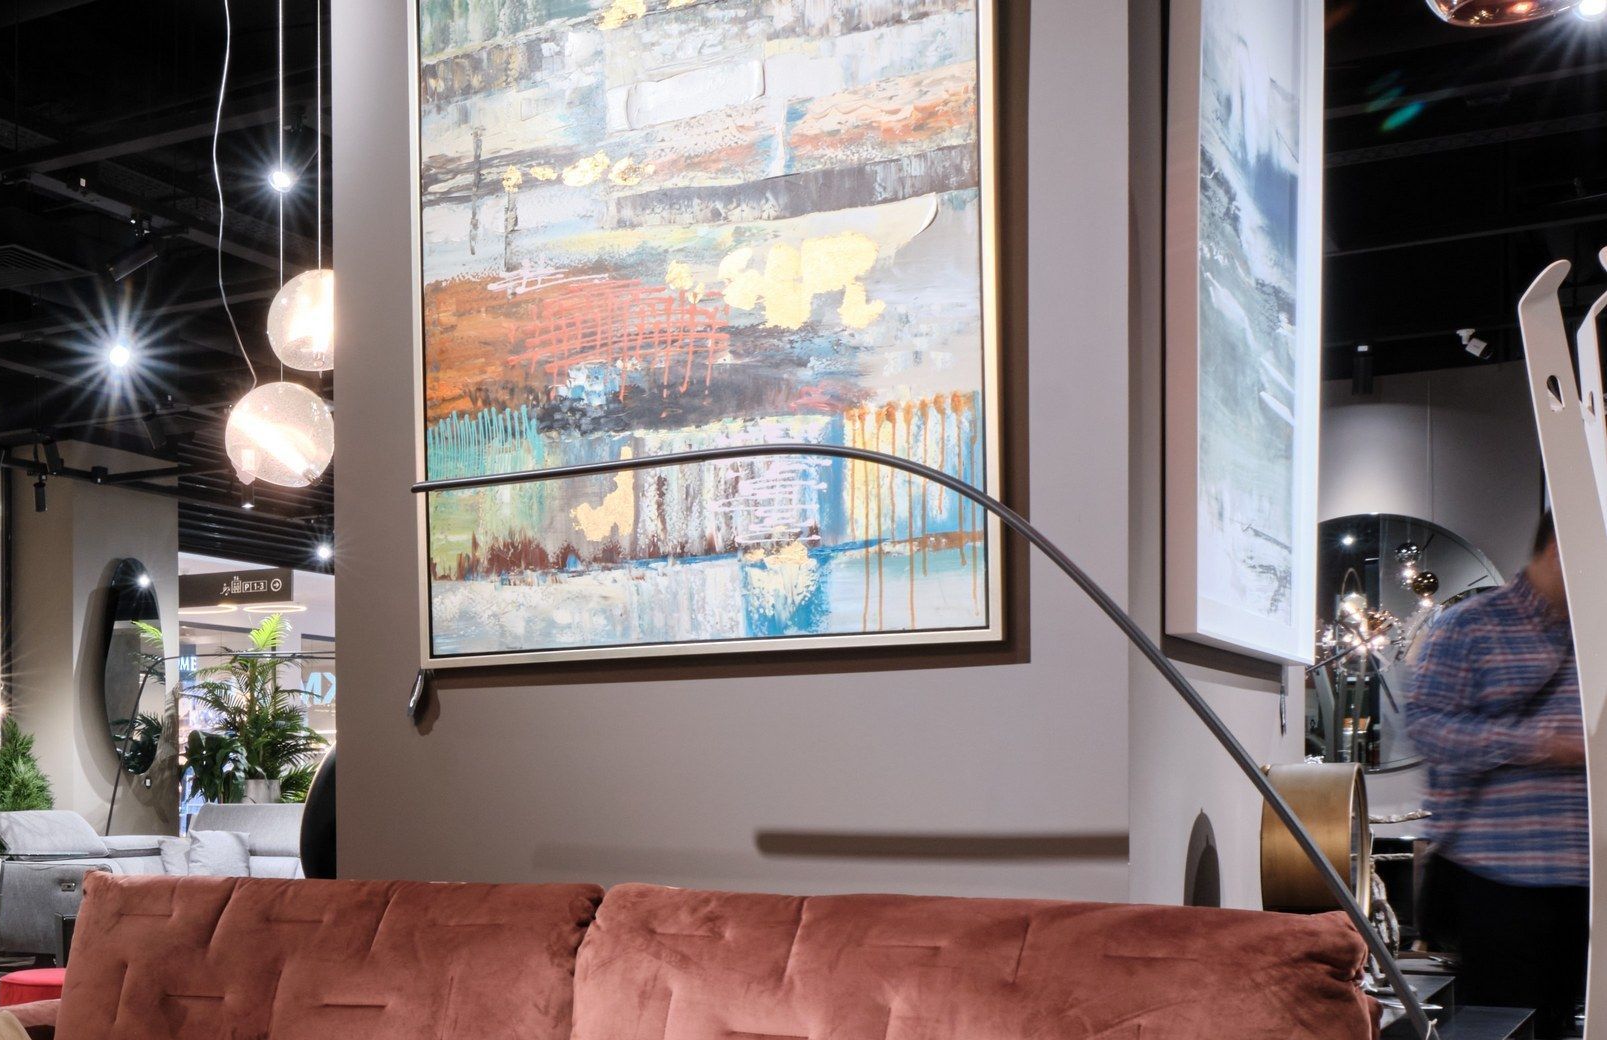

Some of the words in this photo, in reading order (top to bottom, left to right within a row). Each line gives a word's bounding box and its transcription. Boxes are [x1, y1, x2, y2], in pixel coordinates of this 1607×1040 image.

[244, 583, 250, 592] P
[253, 582, 265, 590] 1-3
[179, 656, 197, 671] ME
